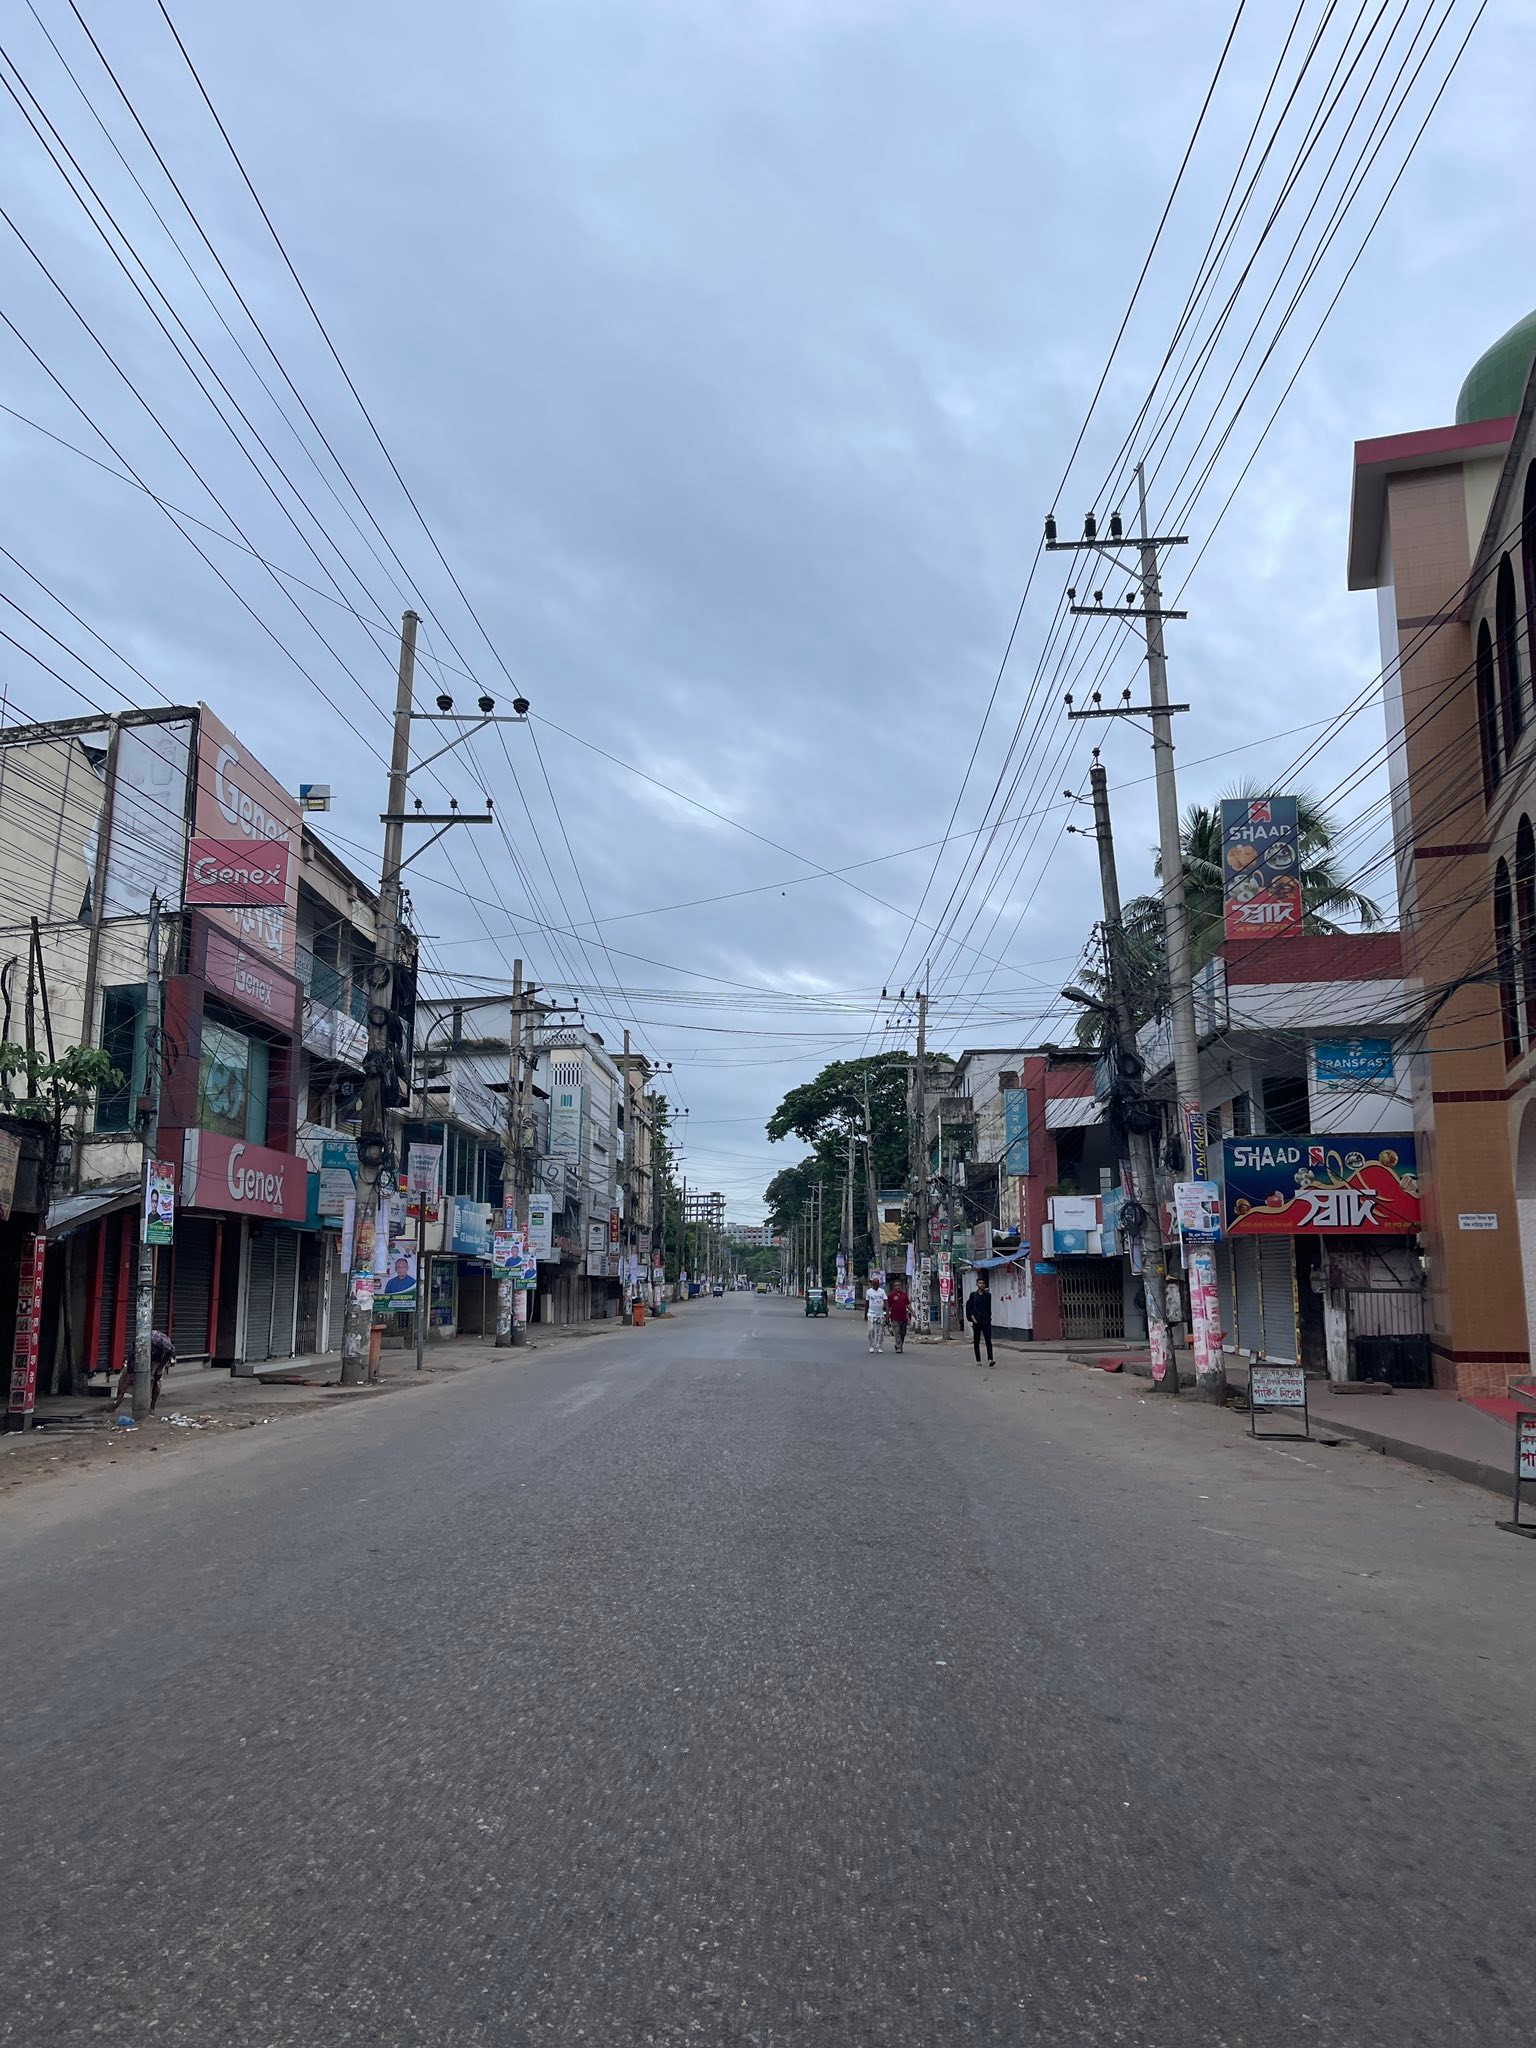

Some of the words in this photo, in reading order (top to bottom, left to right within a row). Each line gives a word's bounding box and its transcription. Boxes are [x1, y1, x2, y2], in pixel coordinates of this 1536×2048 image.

[1230, 824, 1293, 842] SHAAD
[193, 857, 281, 886] Genex
[1232, 902, 1297, 925] স্বাদ
[234, 951, 273, 1011] Genex
[1234, 1146, 1301, 1171] SHAAD
[228, 1143, 284, 1205] Genex
[1295, 1189, 1380, 1227] স্বাদ
